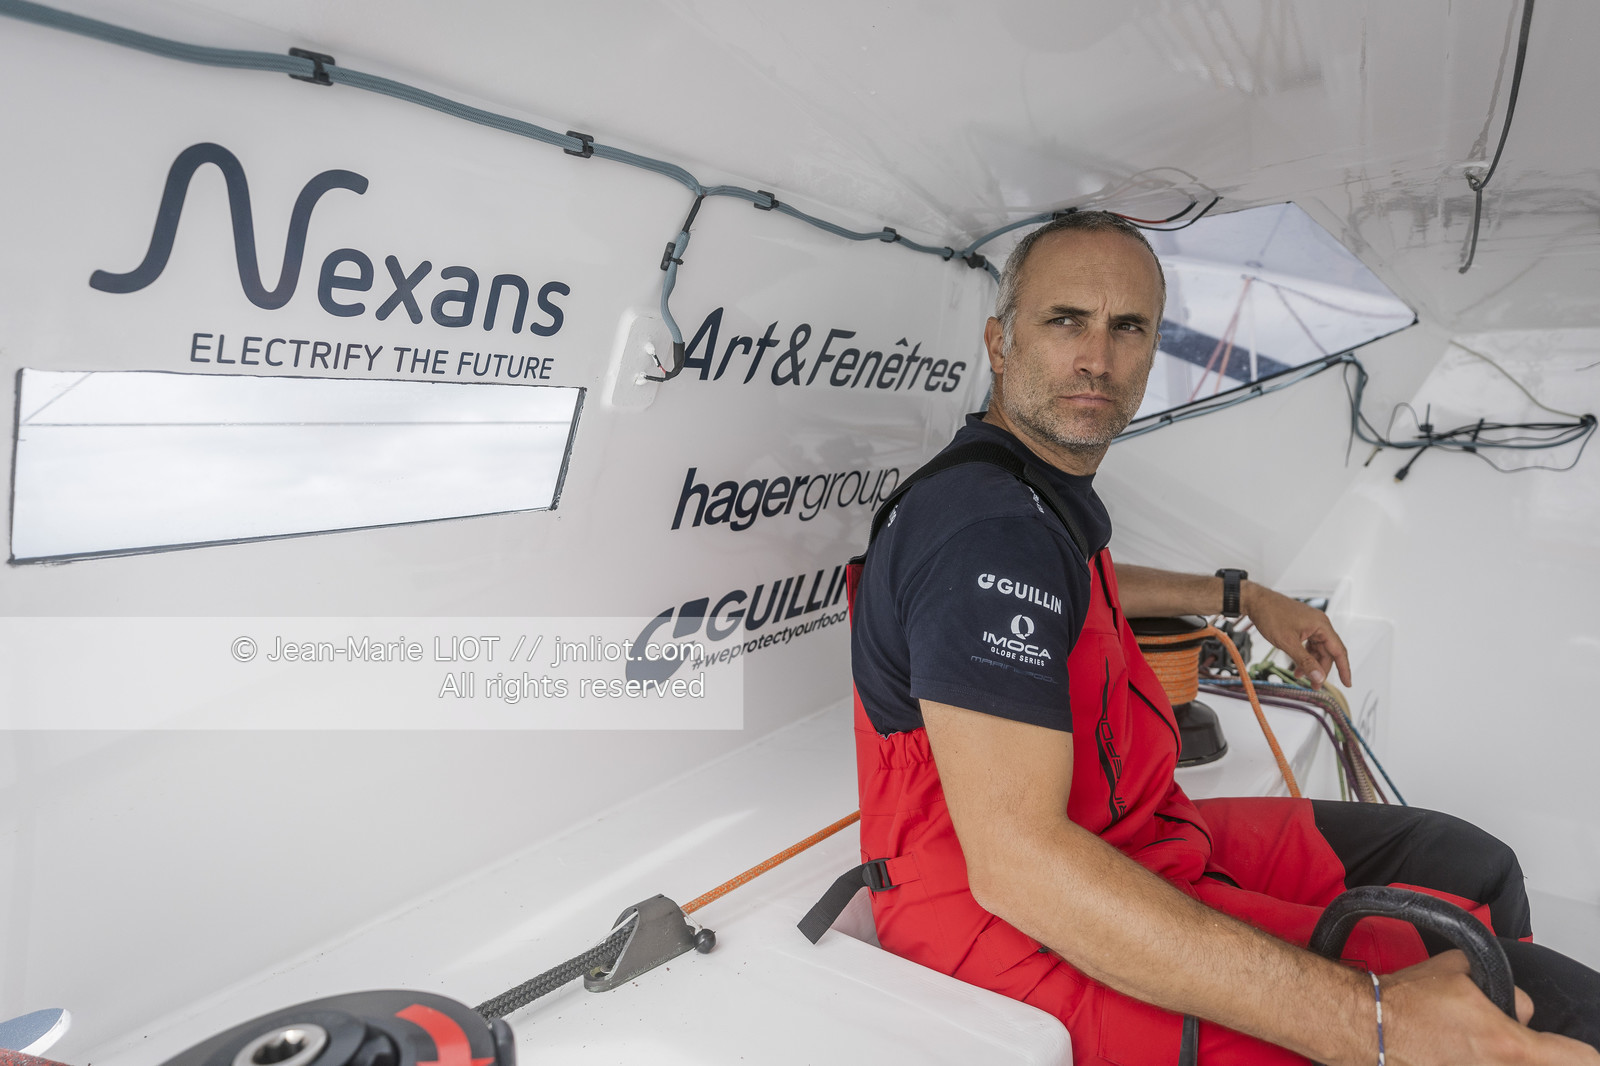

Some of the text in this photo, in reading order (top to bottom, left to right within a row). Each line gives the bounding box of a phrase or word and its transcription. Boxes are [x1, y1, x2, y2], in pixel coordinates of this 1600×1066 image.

[89, 142, 571, 336] Nexans
[190, 333, 555, 379] ELECTRIFY THE FUTURE
[682, 307, 967, 392] Art&Fenêtres
[671, 467, 899, 532] hagergroup
[997, 578, 1062, 615] GUILLIN
[982, 631, 1051, 660] IMOCA
[990, 646, 1045, 667] GLOBE SERIES
